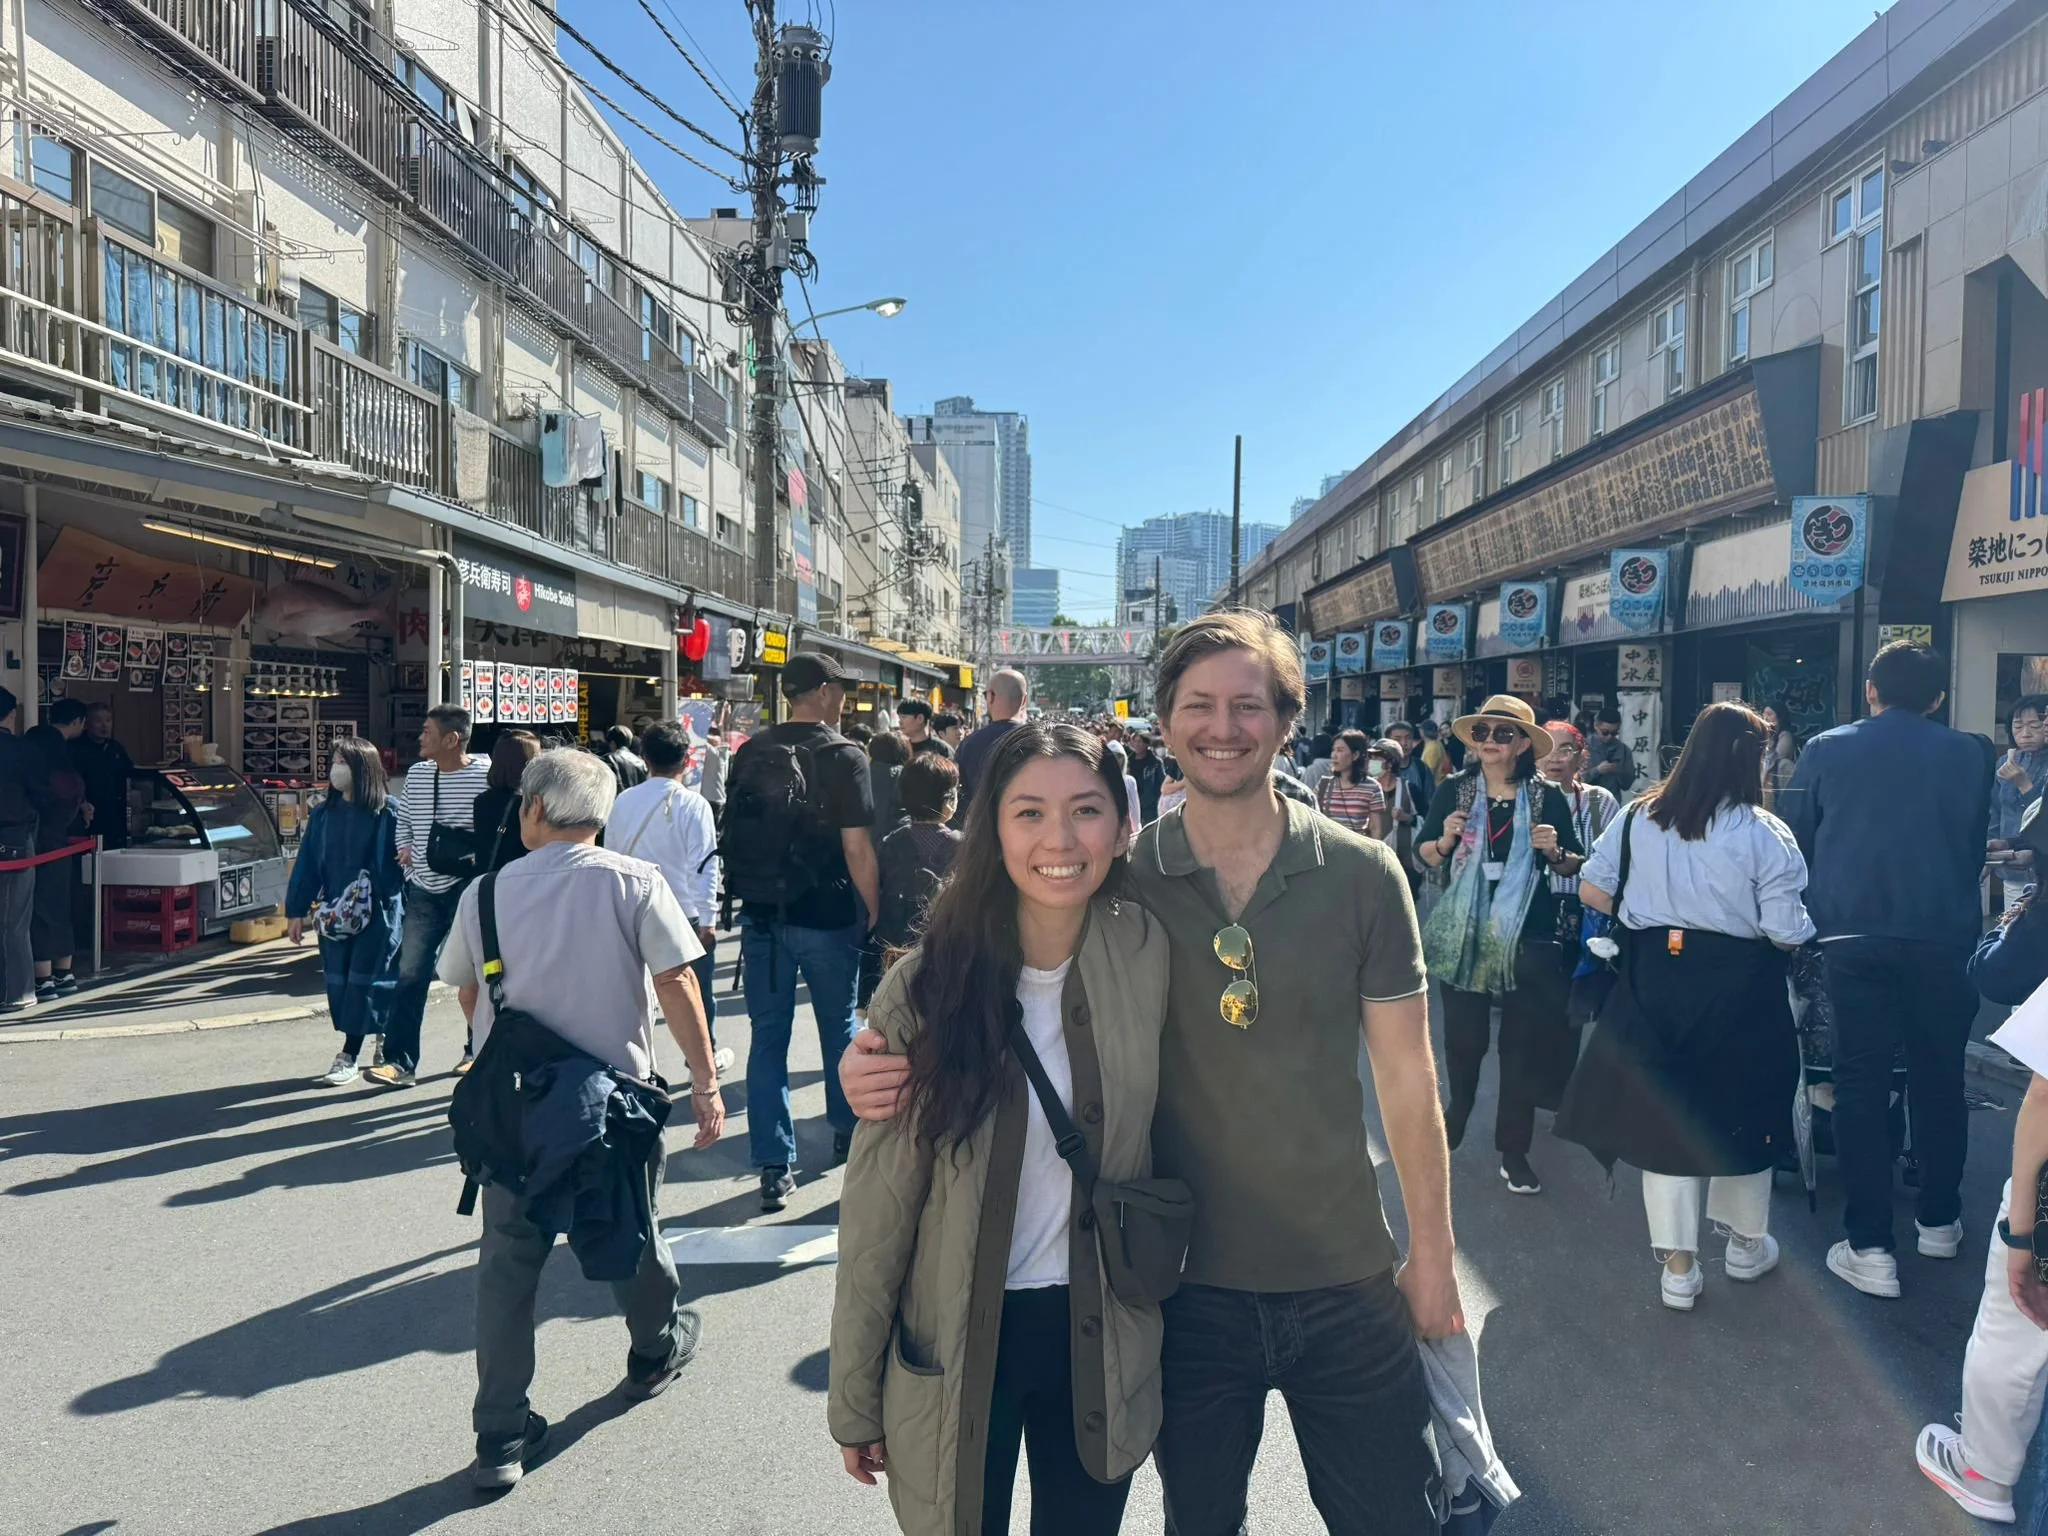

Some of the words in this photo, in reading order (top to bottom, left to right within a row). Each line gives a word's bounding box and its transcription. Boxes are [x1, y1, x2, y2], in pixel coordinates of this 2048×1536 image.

[1968, 529, 2048, 568] 築地にっ
[1979, 570, 2014, 585] TSUKIJI
[534, 582, 558, 604] Hikobe
[559, 589, 575, 608] Sushi
[1892, 625, 1930, 640] コイン
[1625, 648, 1659, 666] 中原
[579, 680, 589, 706] LAB
